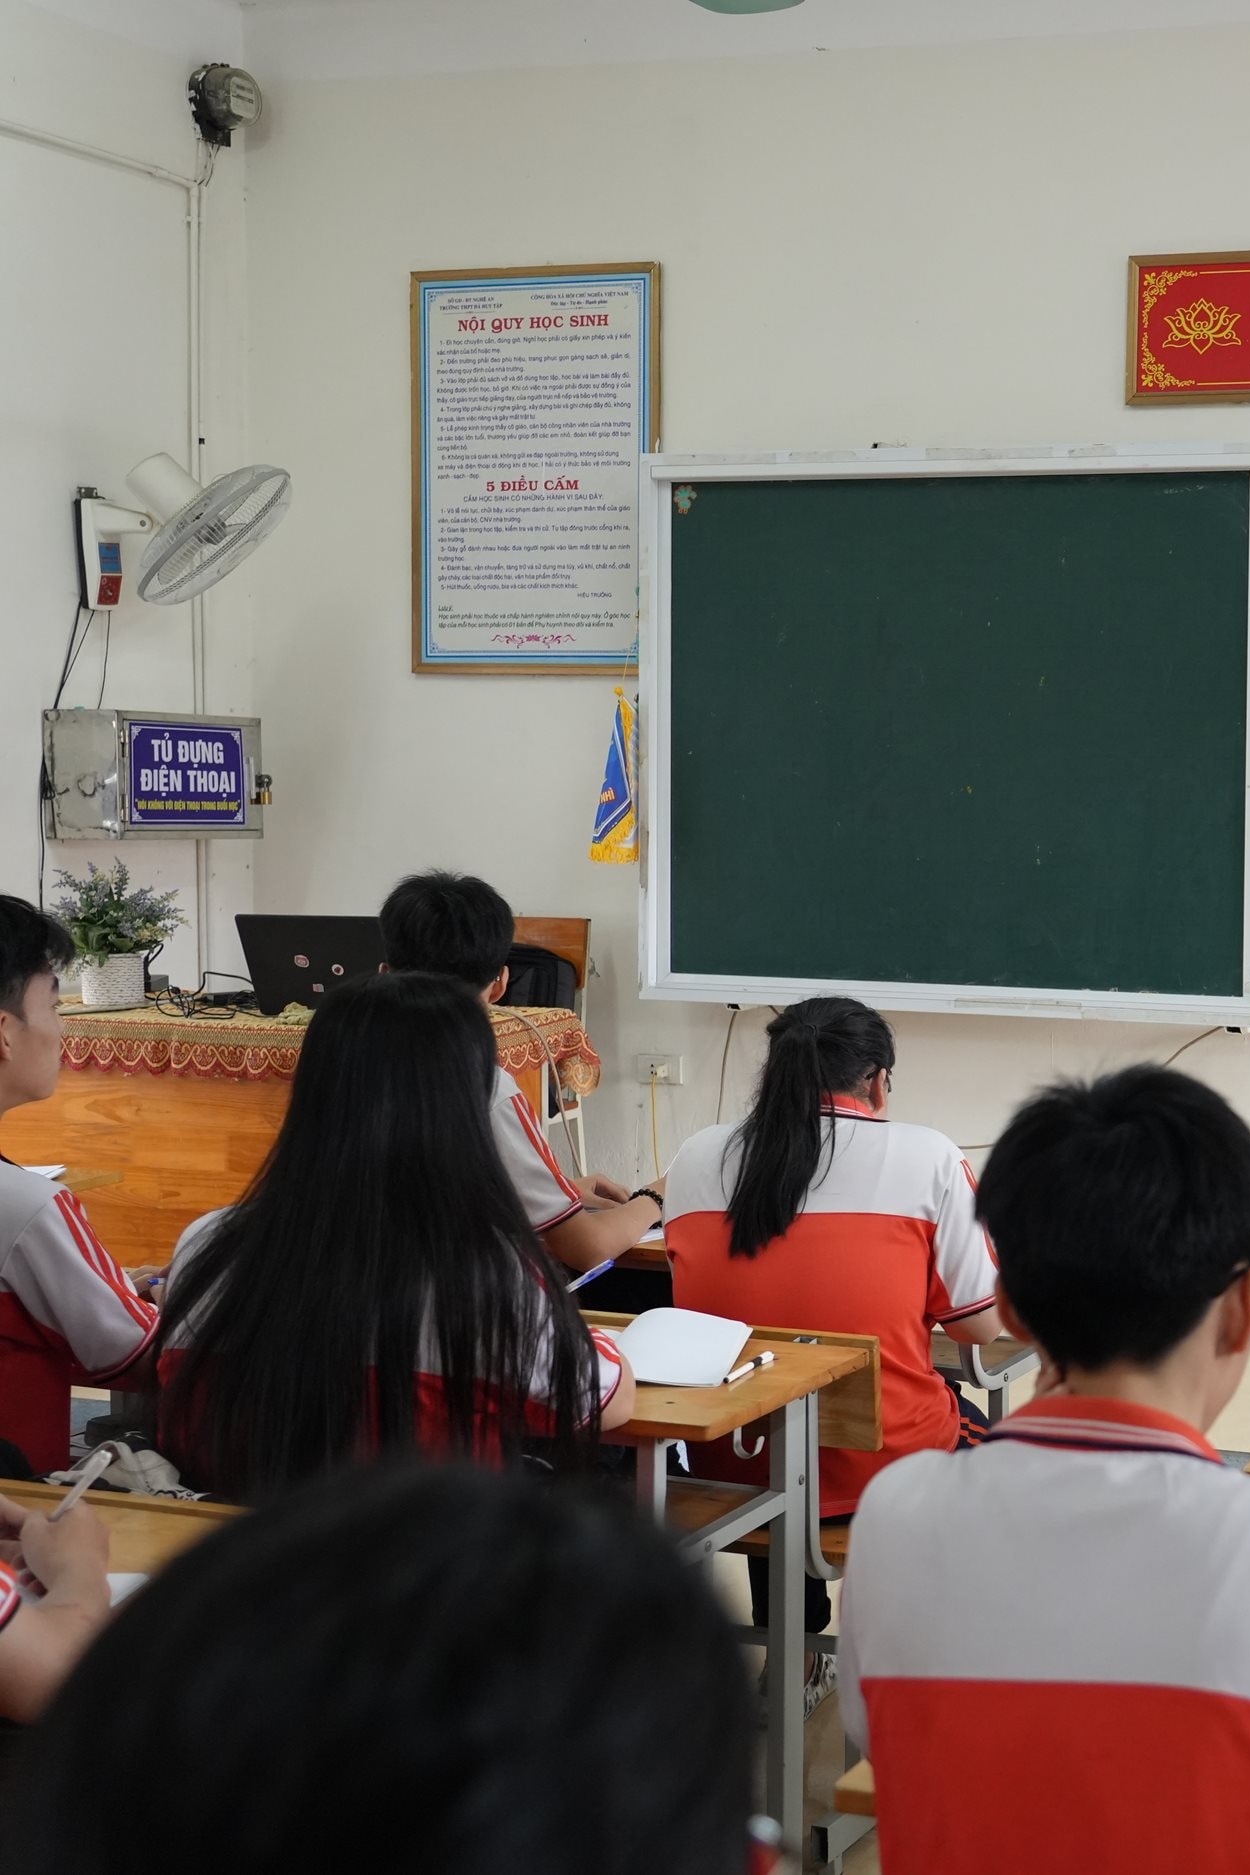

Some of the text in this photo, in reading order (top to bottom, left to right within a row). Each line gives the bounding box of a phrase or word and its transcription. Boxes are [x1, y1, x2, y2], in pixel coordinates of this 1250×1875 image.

[457, 314, 609, 334] NỘI QUY HỌC SINH
[486, 475, 580, 492] 5 ĐIỀU CẤM
[151, 732, 225, 768] TỦ ĐỰNG
[140, 765, 236, 798] ĐIỆN THOẠI
